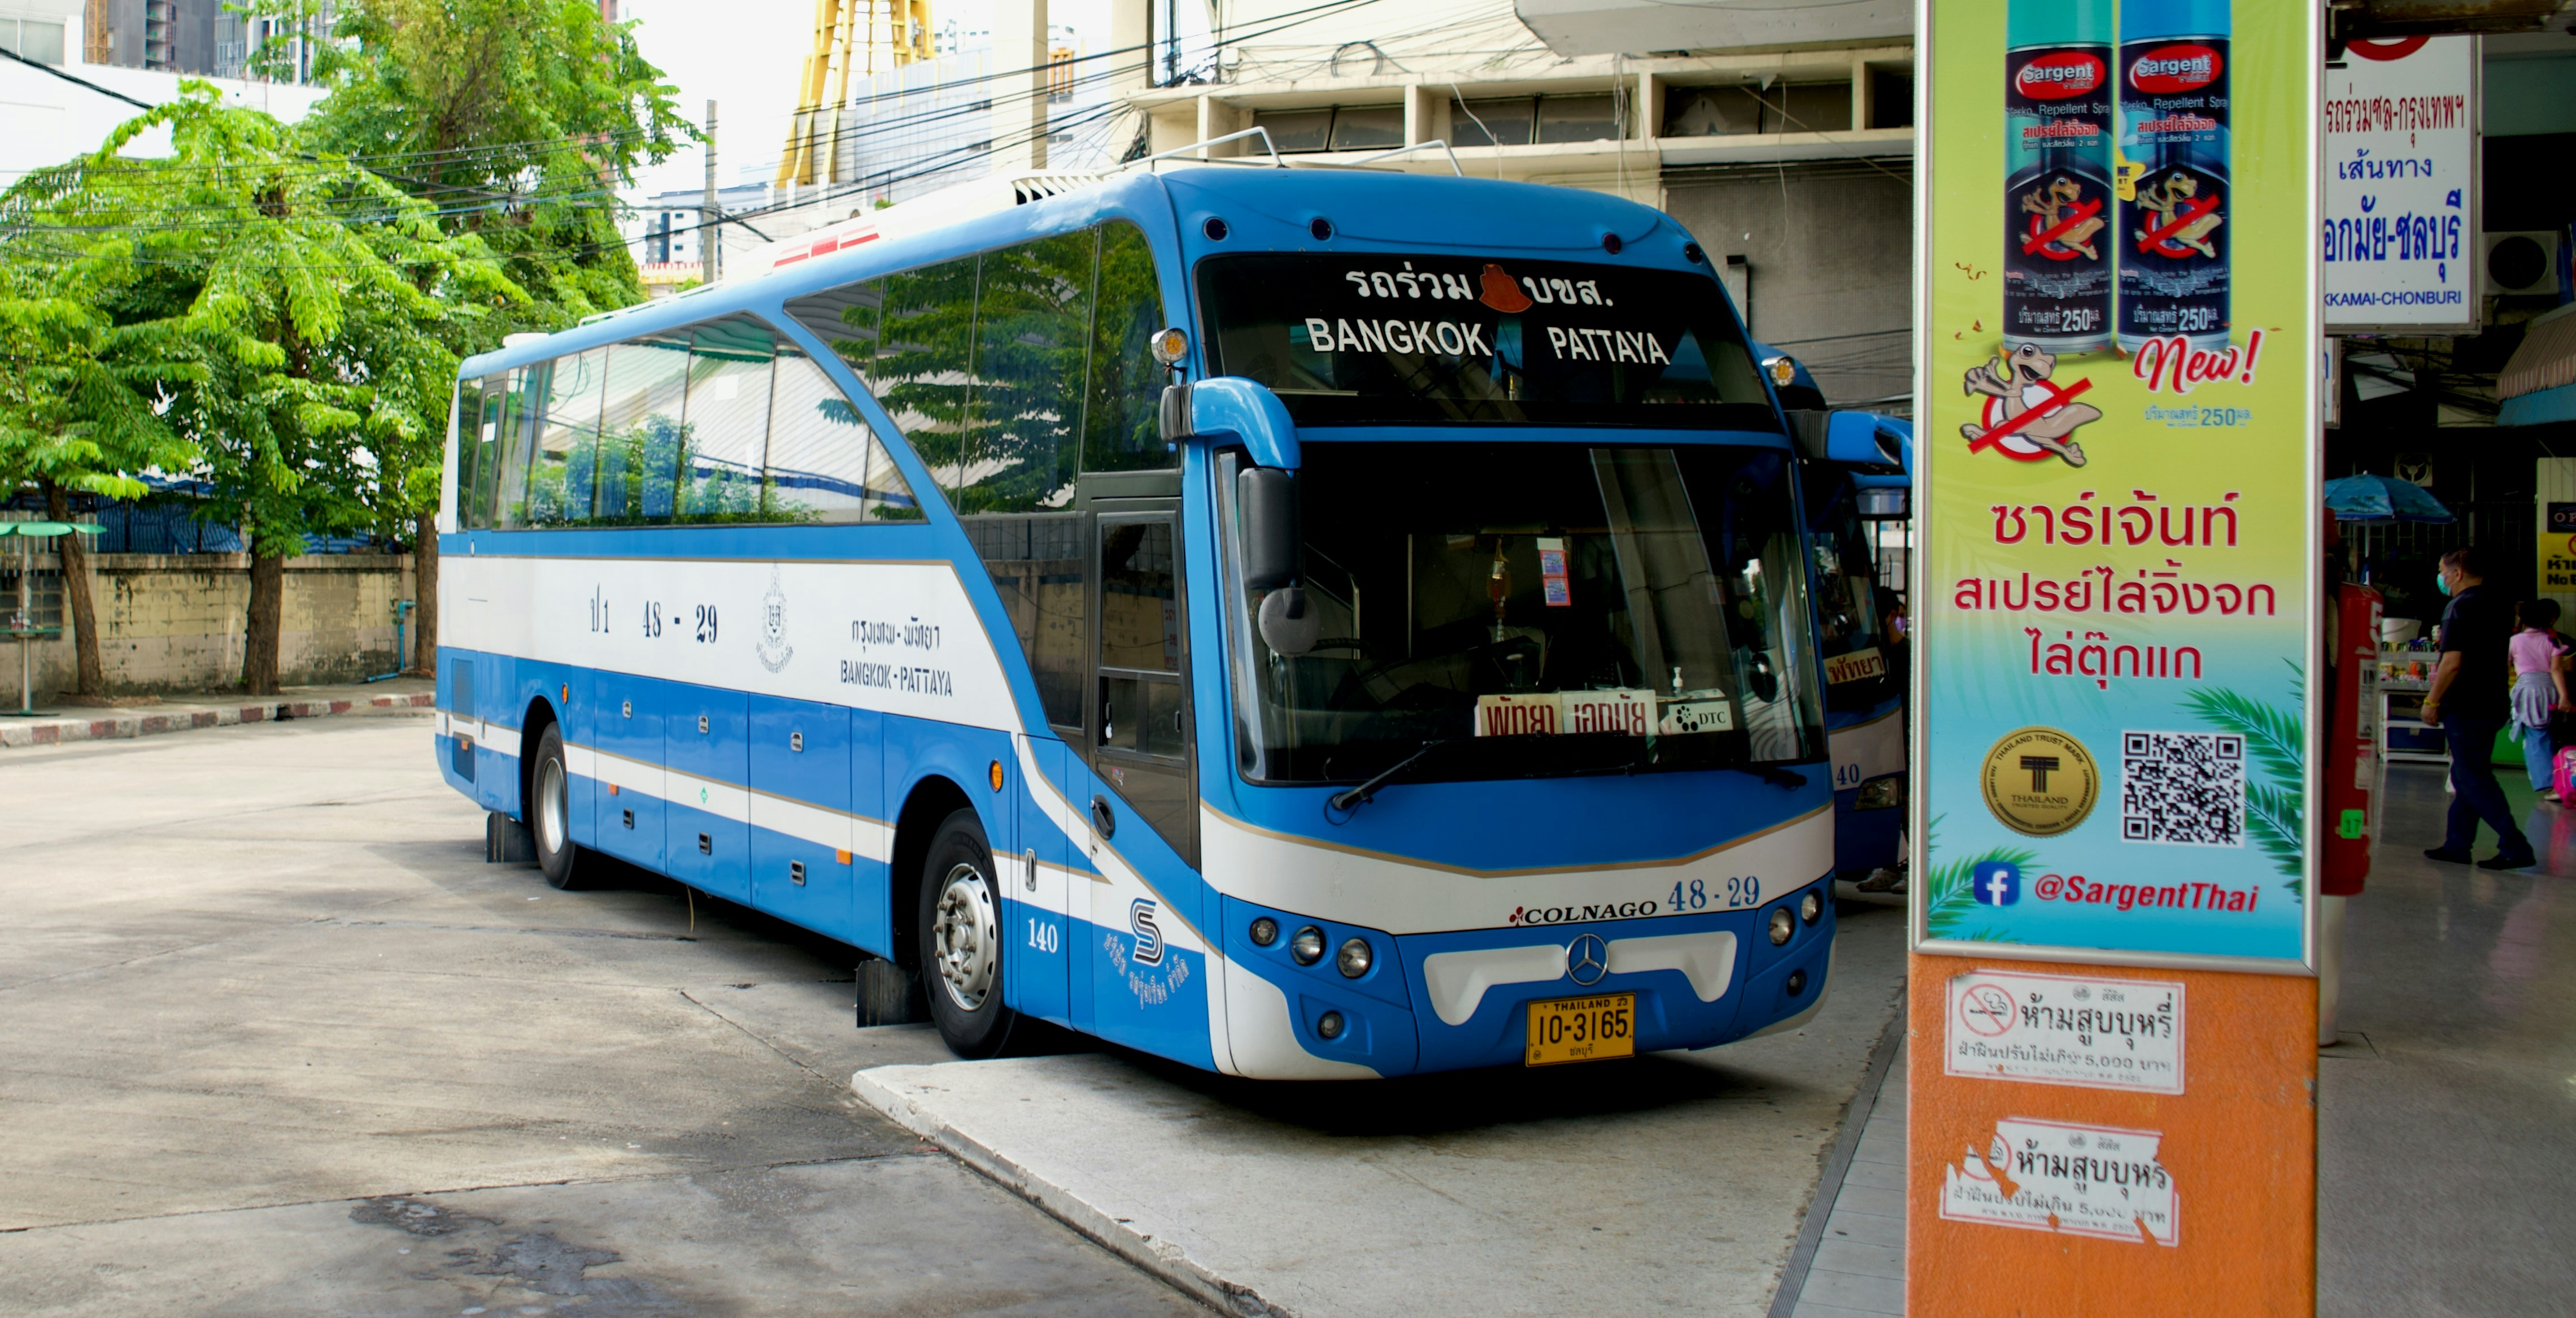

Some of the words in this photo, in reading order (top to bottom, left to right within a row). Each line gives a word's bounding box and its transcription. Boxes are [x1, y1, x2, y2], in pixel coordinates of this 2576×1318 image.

[2023, 63, 2094, 81] Sargent
[2137, 55, 2211, 76] Sargent
[2039, 104, 2087, 116] Repellent
[2154, 98, 2204, 110] Repellent
[2023, 119, 2099, 138] สเปรย์ไล่จิ้งจก
[2138, 114, 2216, 133] สเปรย์ไล่จิ้งจก
[2339, 149, 2432, 180] เส้นทาง
[2325, 189, 2461, 283] อกมัย-ชลบุรี
[1346, 261, 1474, 299] รถร่วม
[1523, 276, 1614, 306] บขส.
[2325, 291, 2461, 306] KKAMAI-CHONBURI
[2062, 309, 2090, 332] 250
[2179, 308, 2208, 331] 250
[1305, 317, 1492, 356] BANGKOK
[1547, 327, 1670, 365] PATTAYA
[2134, 330, 2263, 394] New!
[2201, 408, 2236, 426] 250
[1991, 490, 2239, 546] ซาร์เจ้นท์
[1954, 559, 2275, 616] สเปรย์ไล่จิ้งจก
[643, 601, 661, 637] 48
[696, 604, 717, 643] 29
[1829, 656, 1884, 682] พัทยา
[2024, 627, 2202, 690] ไล่ตุ๊กแก
[1487, 696, 1555, 736] พัทยา
[1699, 711, 1726, 725] DTC
[1996, 736, 2032, 761] THAILAND
[2035, 734, 2063, 746] TRUST
[2064, 743, 2085, 764] MARK
[2012, 794, 2068, 804] THAILAND
[2035, 873, 2260, 913] @SargentThai
[1524, 901, 1657, 924] COLNAGO
[1028, 918, 1058, 953] 140
[1554, 999, 1610, 1011] THAILAND
[1540, 1009, 1628, 1045] 10-3165
[2020, 992, 2173, 1051] ห้ามสูบบุหรี่
[1570, 1043, 1593, 1058] ชลบุรี
[2085, 1055, 2133, 1069] 5,000
[2016, 1138, 2167, 1199] ห้ามสูบบุหร
